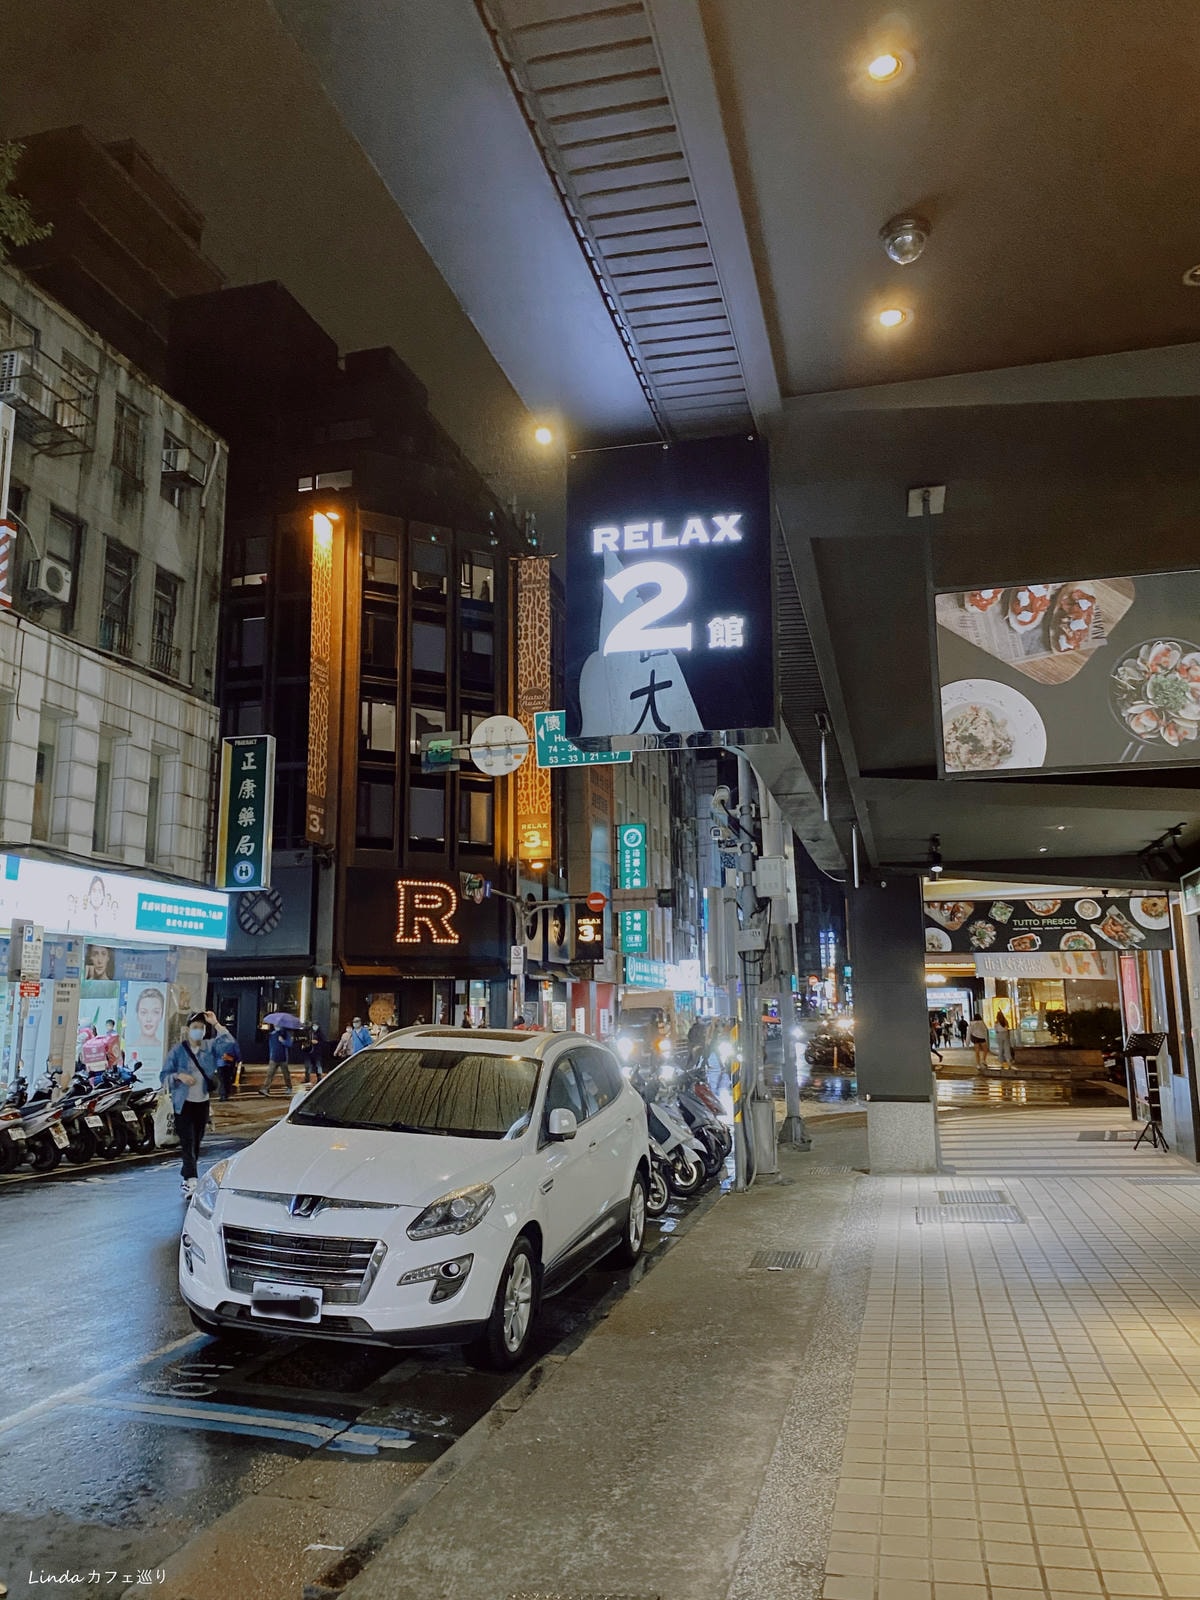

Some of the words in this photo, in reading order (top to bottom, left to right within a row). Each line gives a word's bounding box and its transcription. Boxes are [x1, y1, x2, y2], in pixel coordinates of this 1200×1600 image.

[592, 514, 743, 554] RELAX
[603, 562, 692, 656] 2
[708, 616, 744, 648] 館
[544, 715, 561, 732] 懷
[235, 752, 257, 857] 正康藥局
[521, 822, 548, 830] RELAX
[396, 880, 460, 944] R
[1041, 918, 1077, 926] FRESCO
